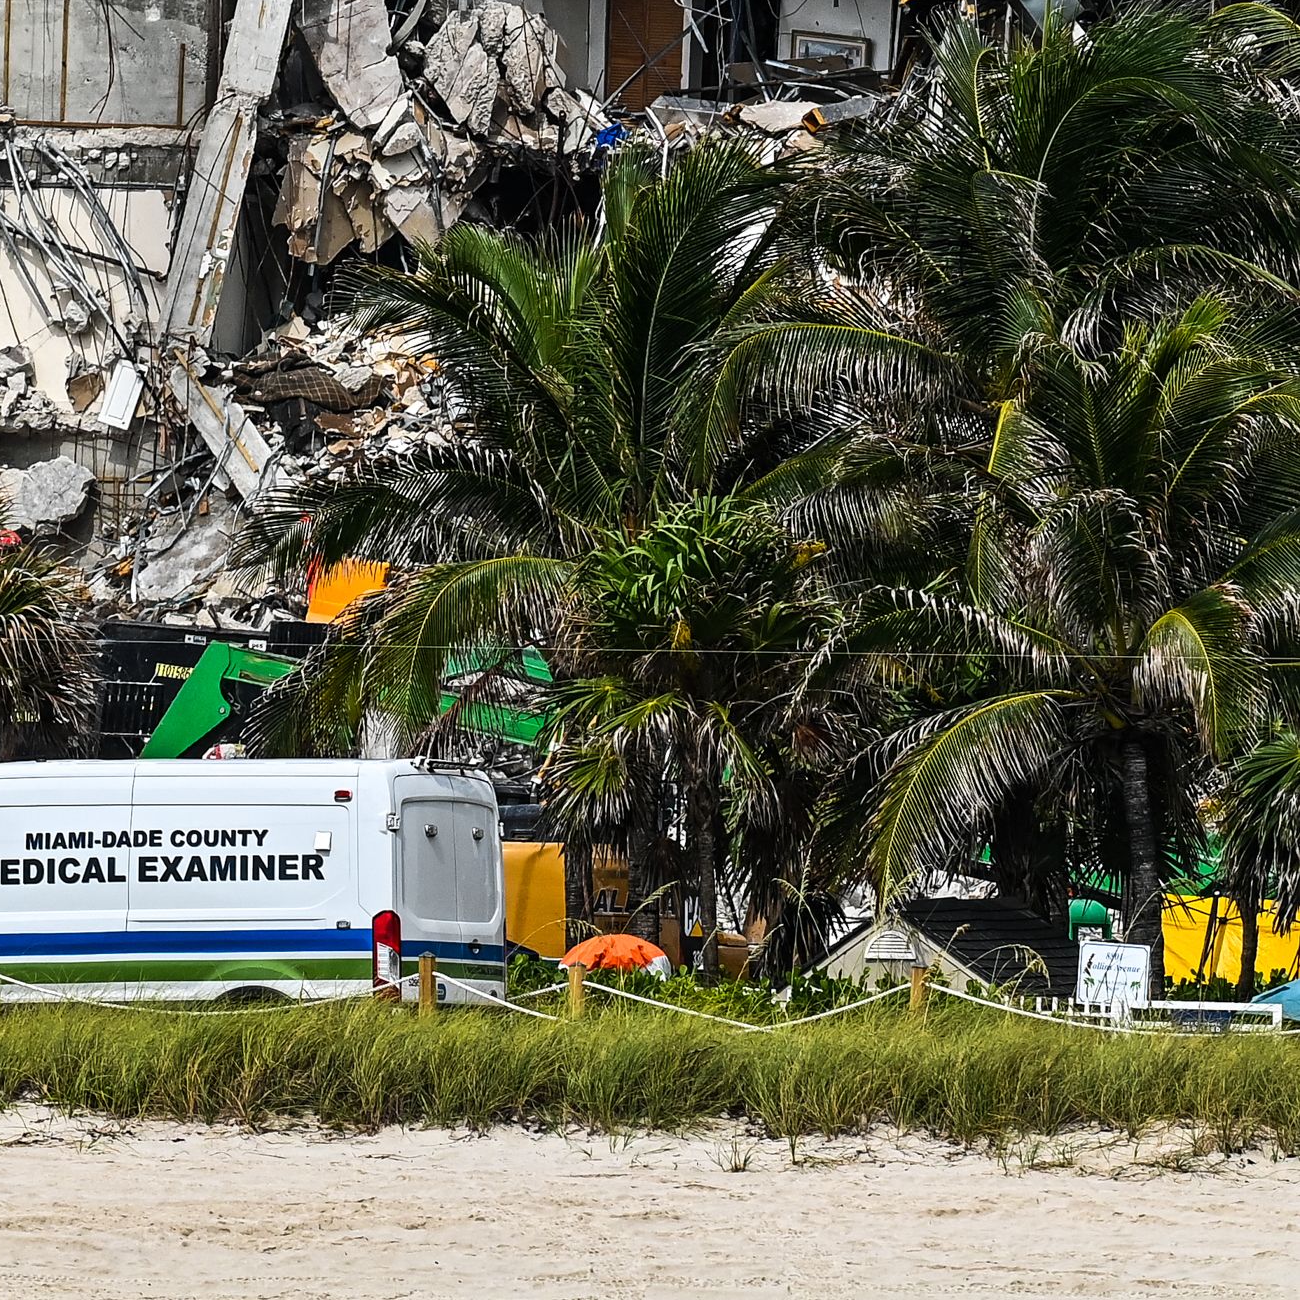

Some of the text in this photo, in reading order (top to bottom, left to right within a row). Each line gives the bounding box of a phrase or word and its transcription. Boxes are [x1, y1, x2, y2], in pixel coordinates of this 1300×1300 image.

[25, 829, 269, 850] MIAMI-DADE COUNTY
[138, 854, 325, 882] EXAMINER
